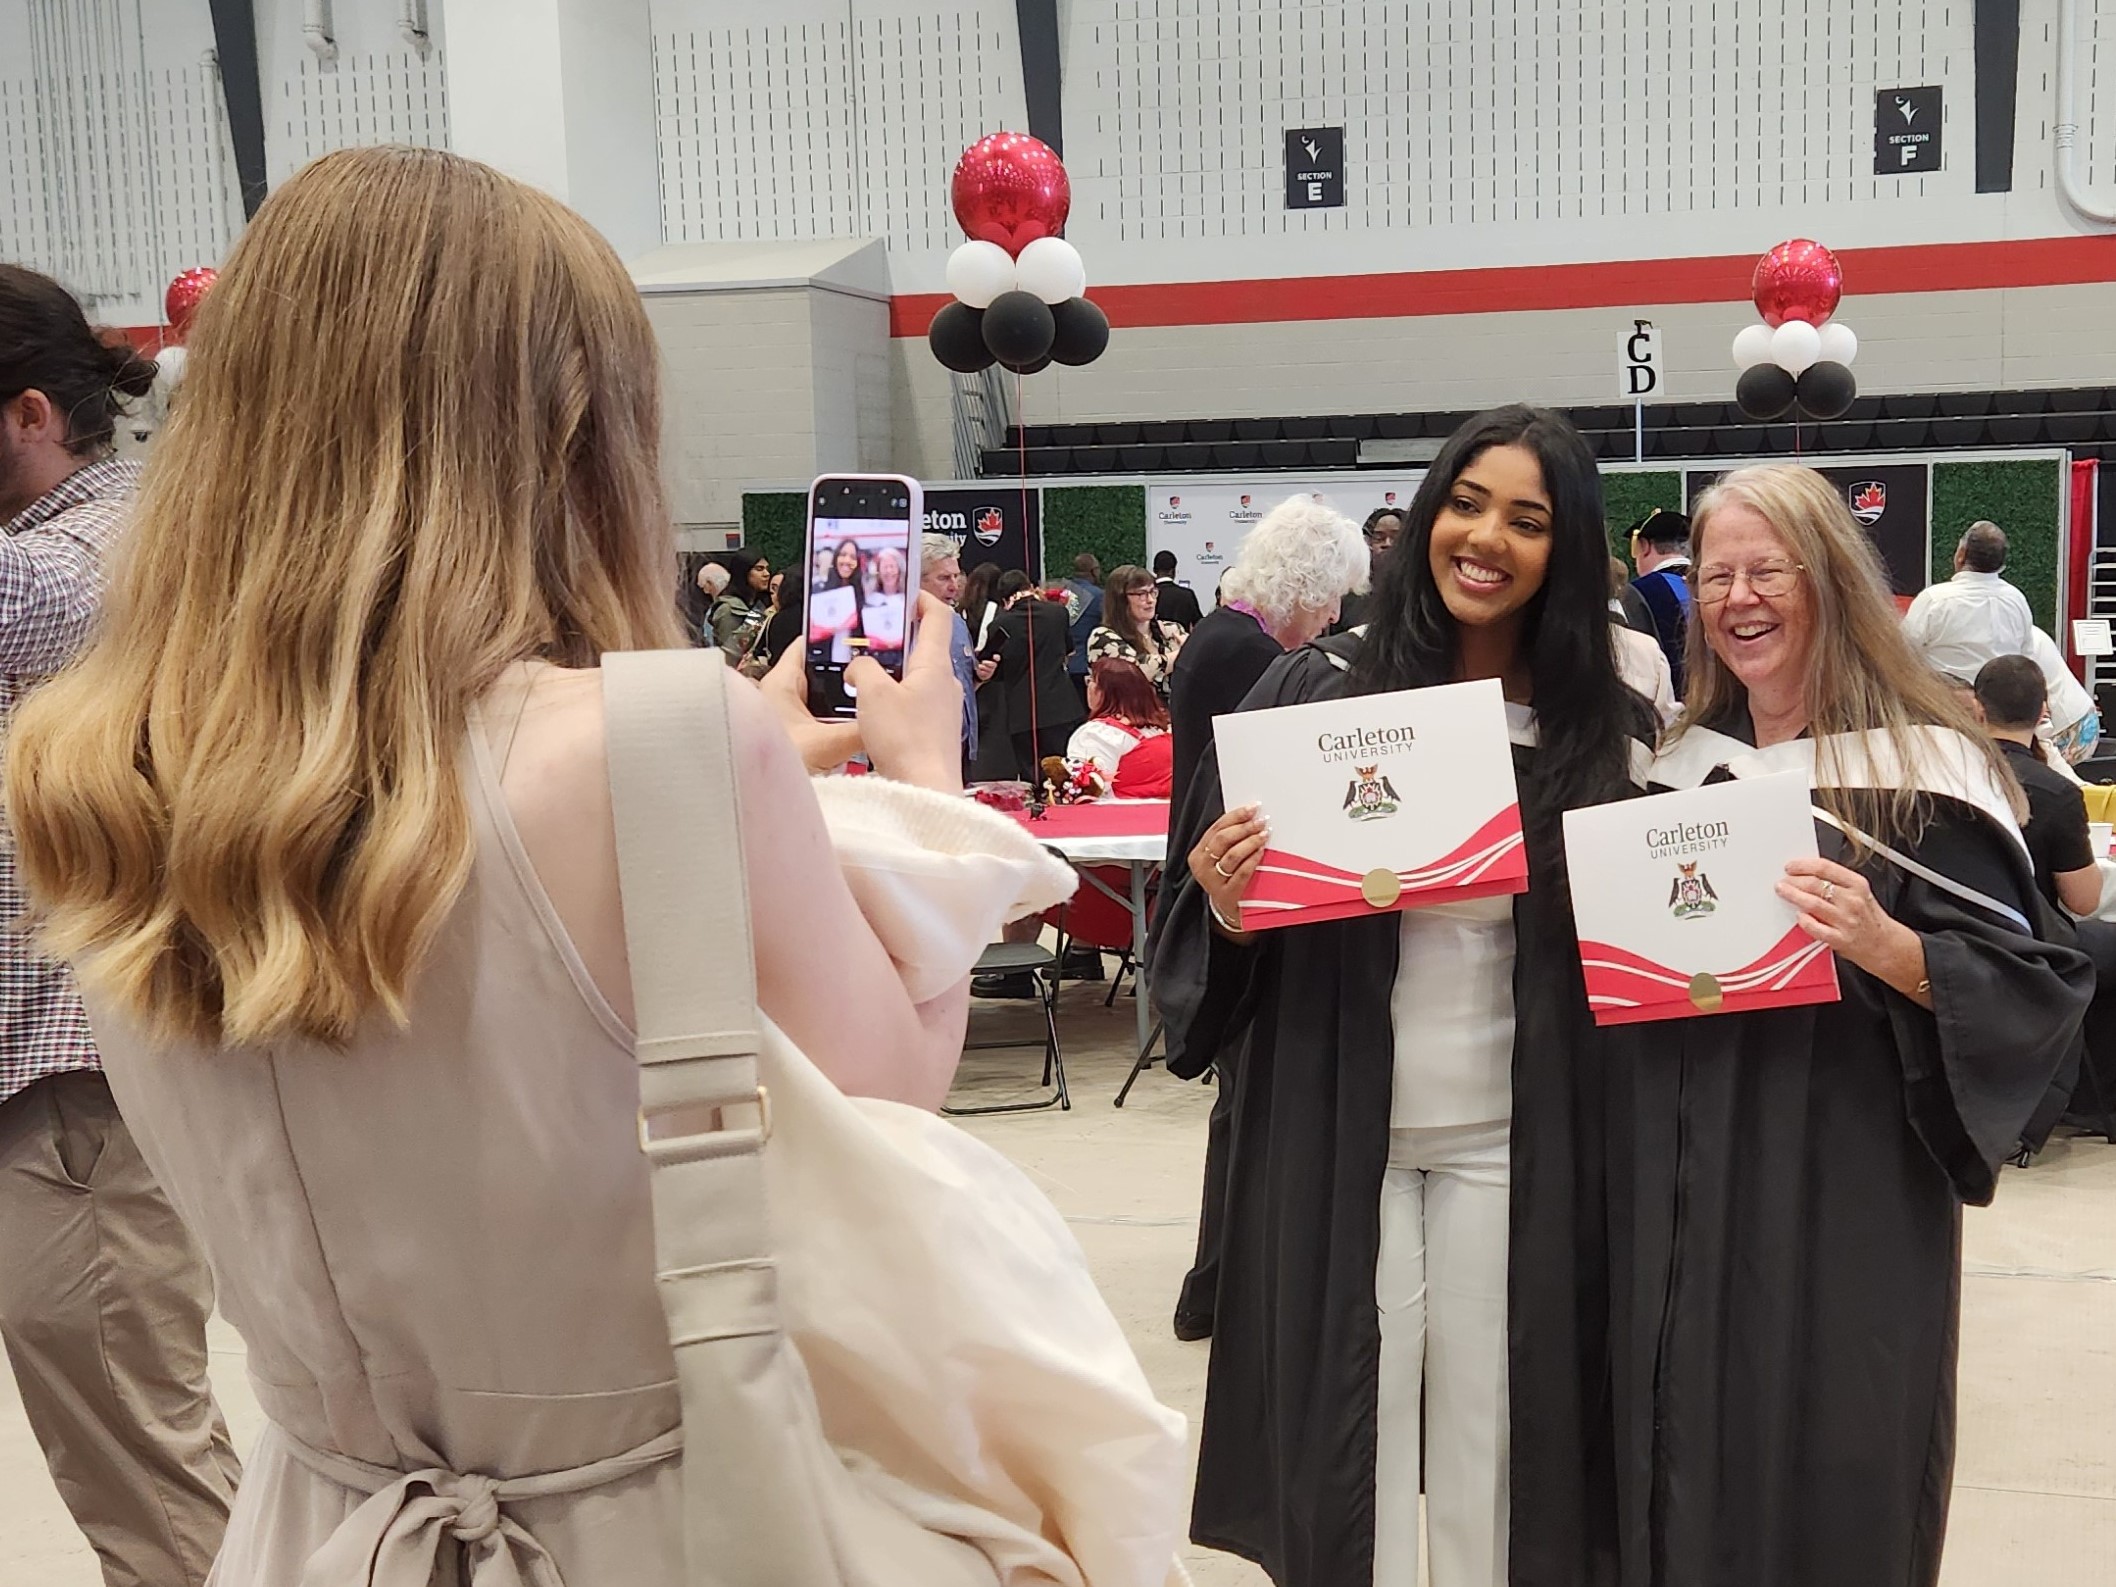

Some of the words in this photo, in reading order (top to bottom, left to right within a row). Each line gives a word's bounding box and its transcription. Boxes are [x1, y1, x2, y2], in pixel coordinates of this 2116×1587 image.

[1888, 133, 1930, 144] SECTION
[1901, 145, 1917, 166] F
[1297, 171, 1332, 181] SECTION
[1308, 182, 1322, 201] E
[1627, 333, 1652, 363] C
[1626, 365, 1656, 394] D
[922, 509, 967, 530] eton
[1318, 726, 1416, 752] Carleton
[1323, 742, 1413, 763] UNIVERSITY
[1646, 821, 1729, 848] Carleton
[1650, 838, 1727, 859] UNIVERSITY
